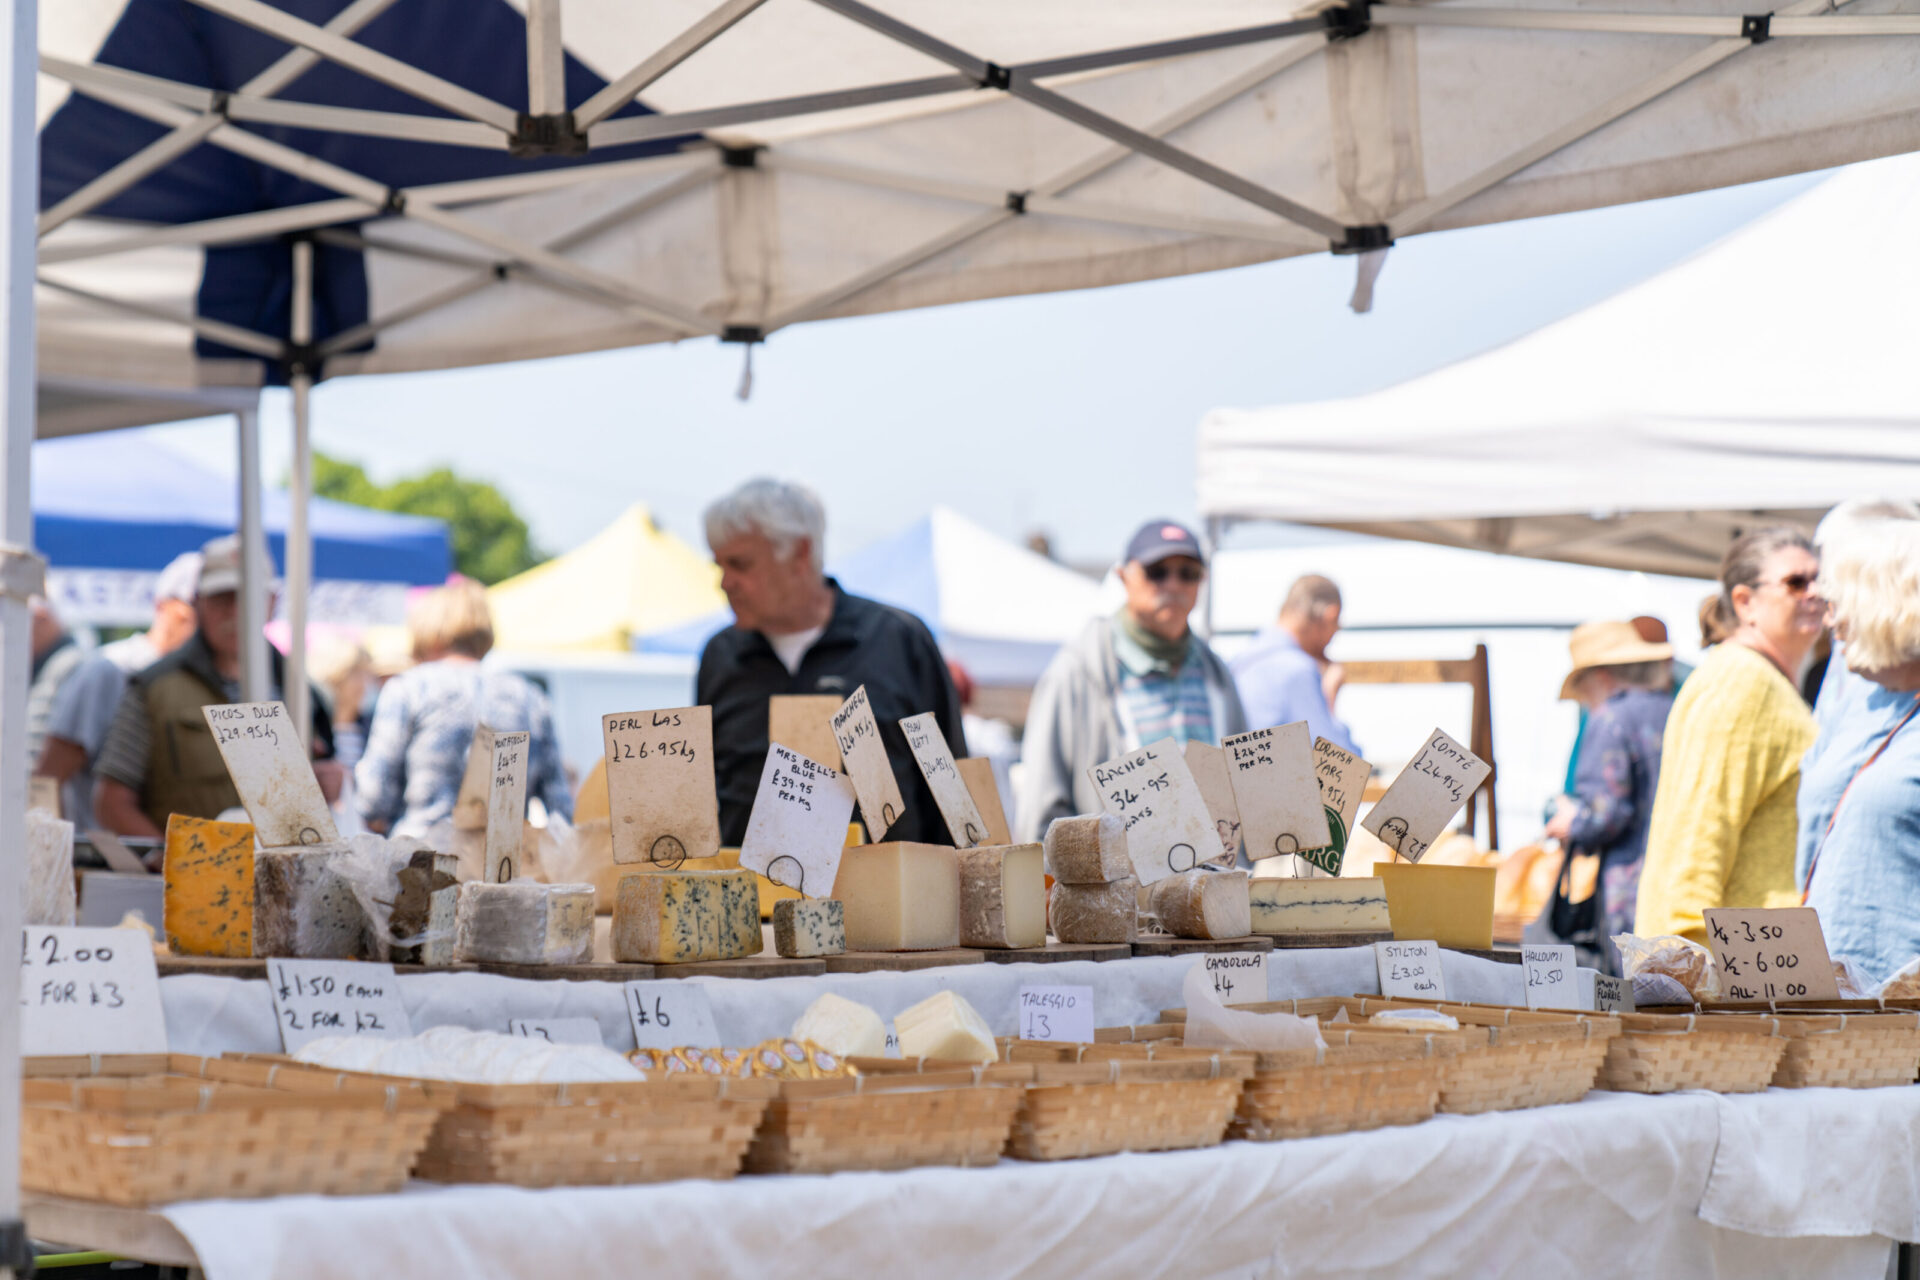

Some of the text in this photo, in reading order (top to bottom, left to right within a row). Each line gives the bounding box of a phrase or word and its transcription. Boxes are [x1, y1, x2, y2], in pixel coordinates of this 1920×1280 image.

[210, 705, 281, 721] PICOS BLUE
[609, 712, 682, 733] PERL LAS
[1314, 739, 1353, 765] CORNISH
[776, 748, 837, 779] MRS BELL'S
[791, 764, 816, 781] BLUE
[1096, 751, 1159, 788] RACHEL
[1239, 761, 1256, 771] PER
[772, 769, 813, 794] £39.95
[778, 790, 795, 802] PER
[1385, 946, 1428, 959] STILTON
[1524, 949, 1563, 963] HALLOUMI
[1391, 966, 1425, 981] £3.00
[40, 980, 78, 1005] FOR
[1214, 972, 1235, 998] £4
[1414, 979, 1438, 991] each
[635, 989, 671, 1028] £6
[1021, 992, 1077, 1009] TALEGGIO
[283, 1009, 304, 1030] 2
[311, 1011, 345, 1029] FOR
[1026, 1011, 1052, 1040] £3
